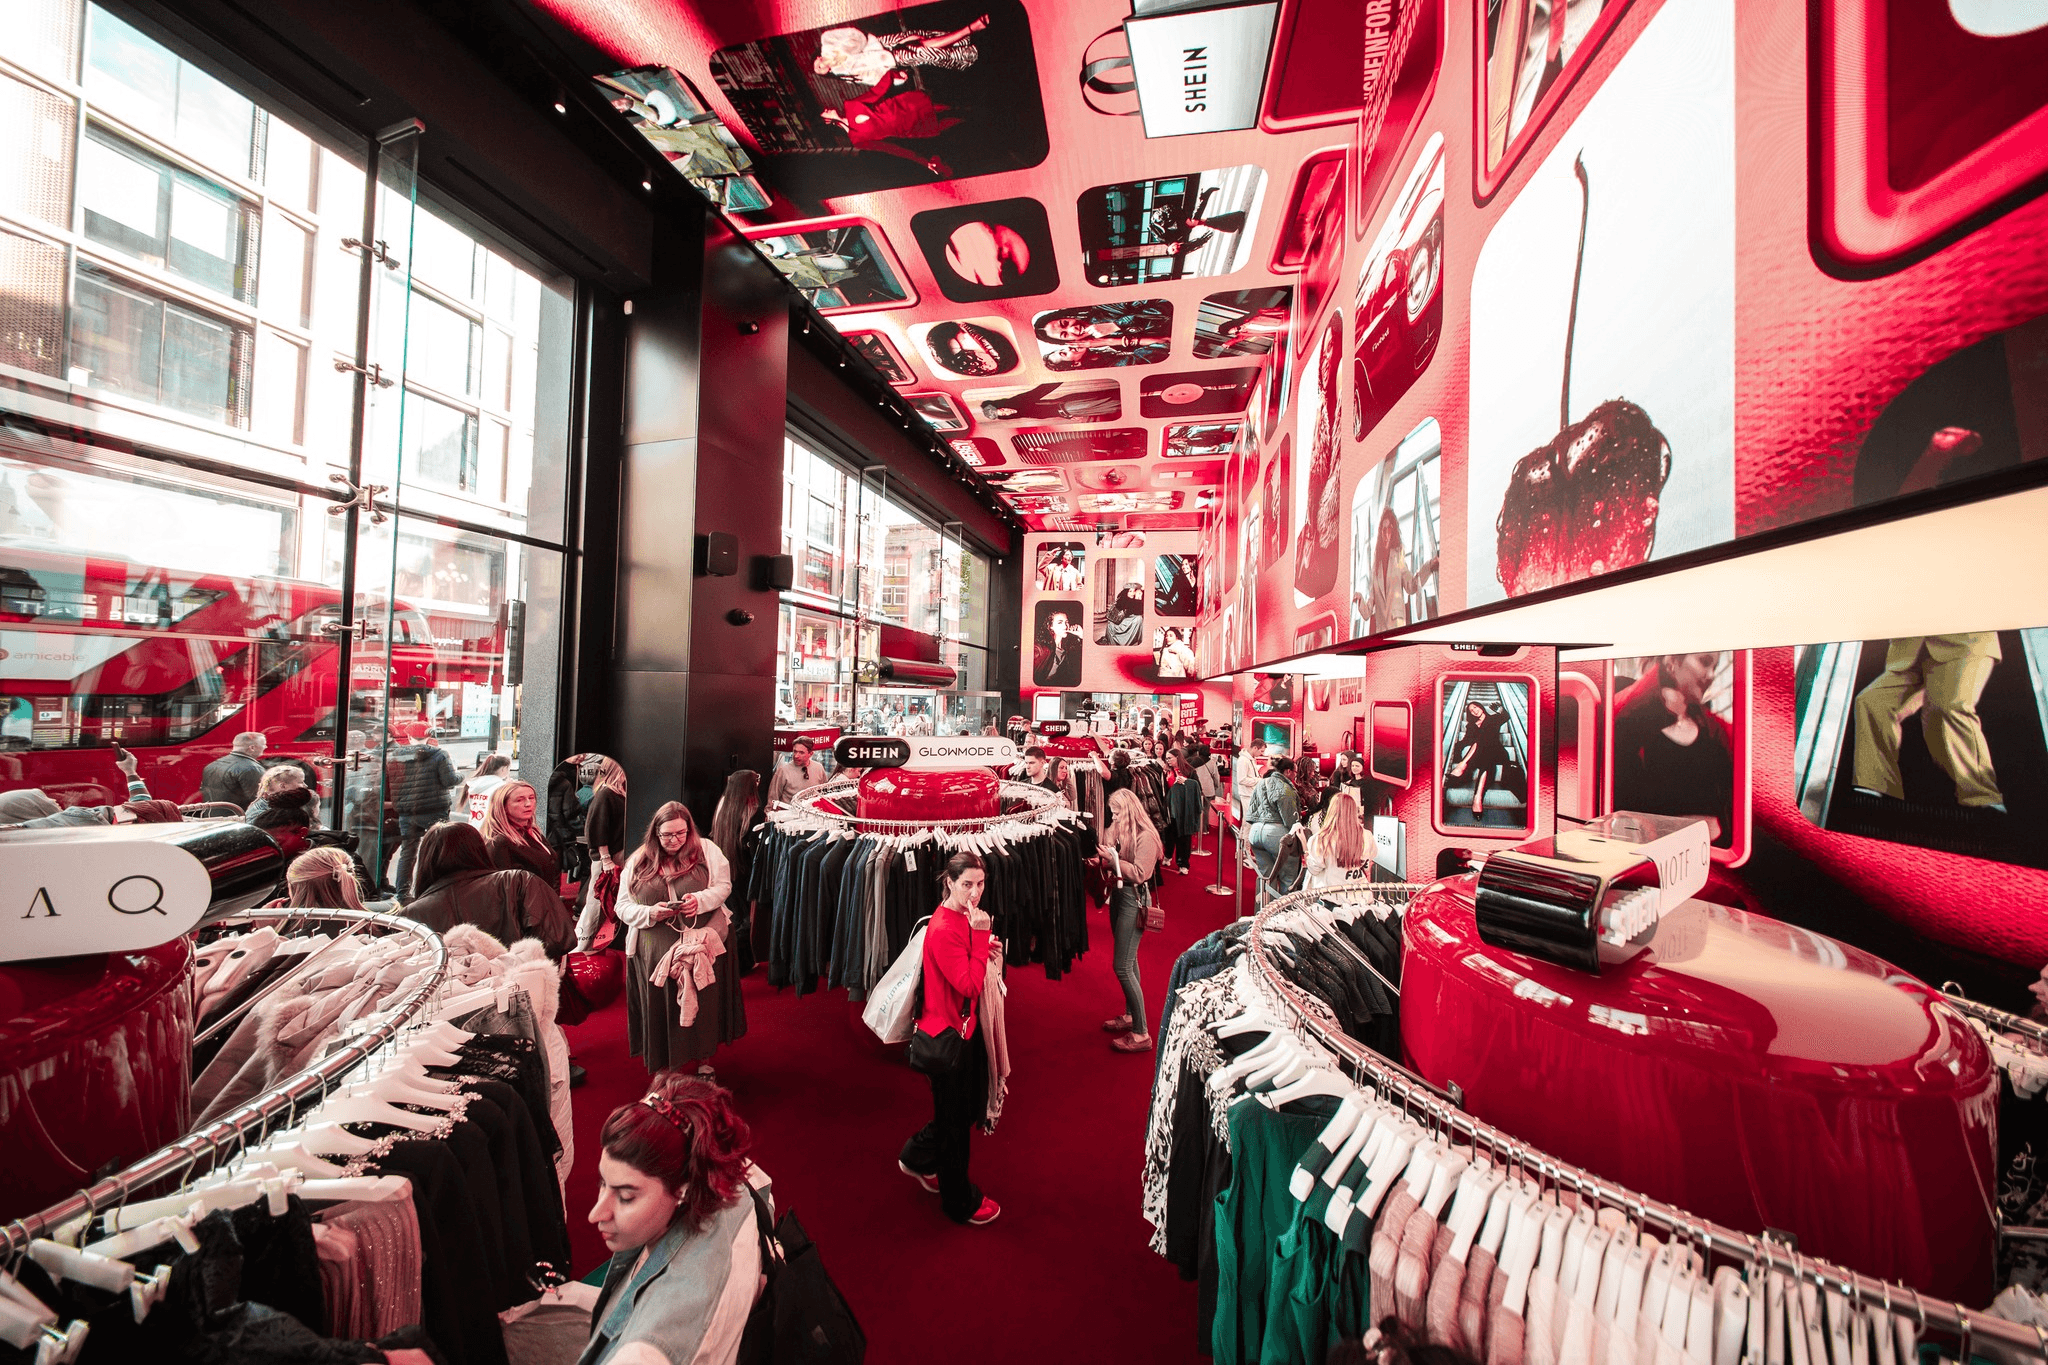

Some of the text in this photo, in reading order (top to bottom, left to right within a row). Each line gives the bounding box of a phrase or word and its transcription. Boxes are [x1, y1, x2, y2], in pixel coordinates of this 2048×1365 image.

[1183, 46, 1208, 113] SHEIN
[793, 657, 801, 667] R
[848, 747, 995, 759] SHEIN GLOWMODE
